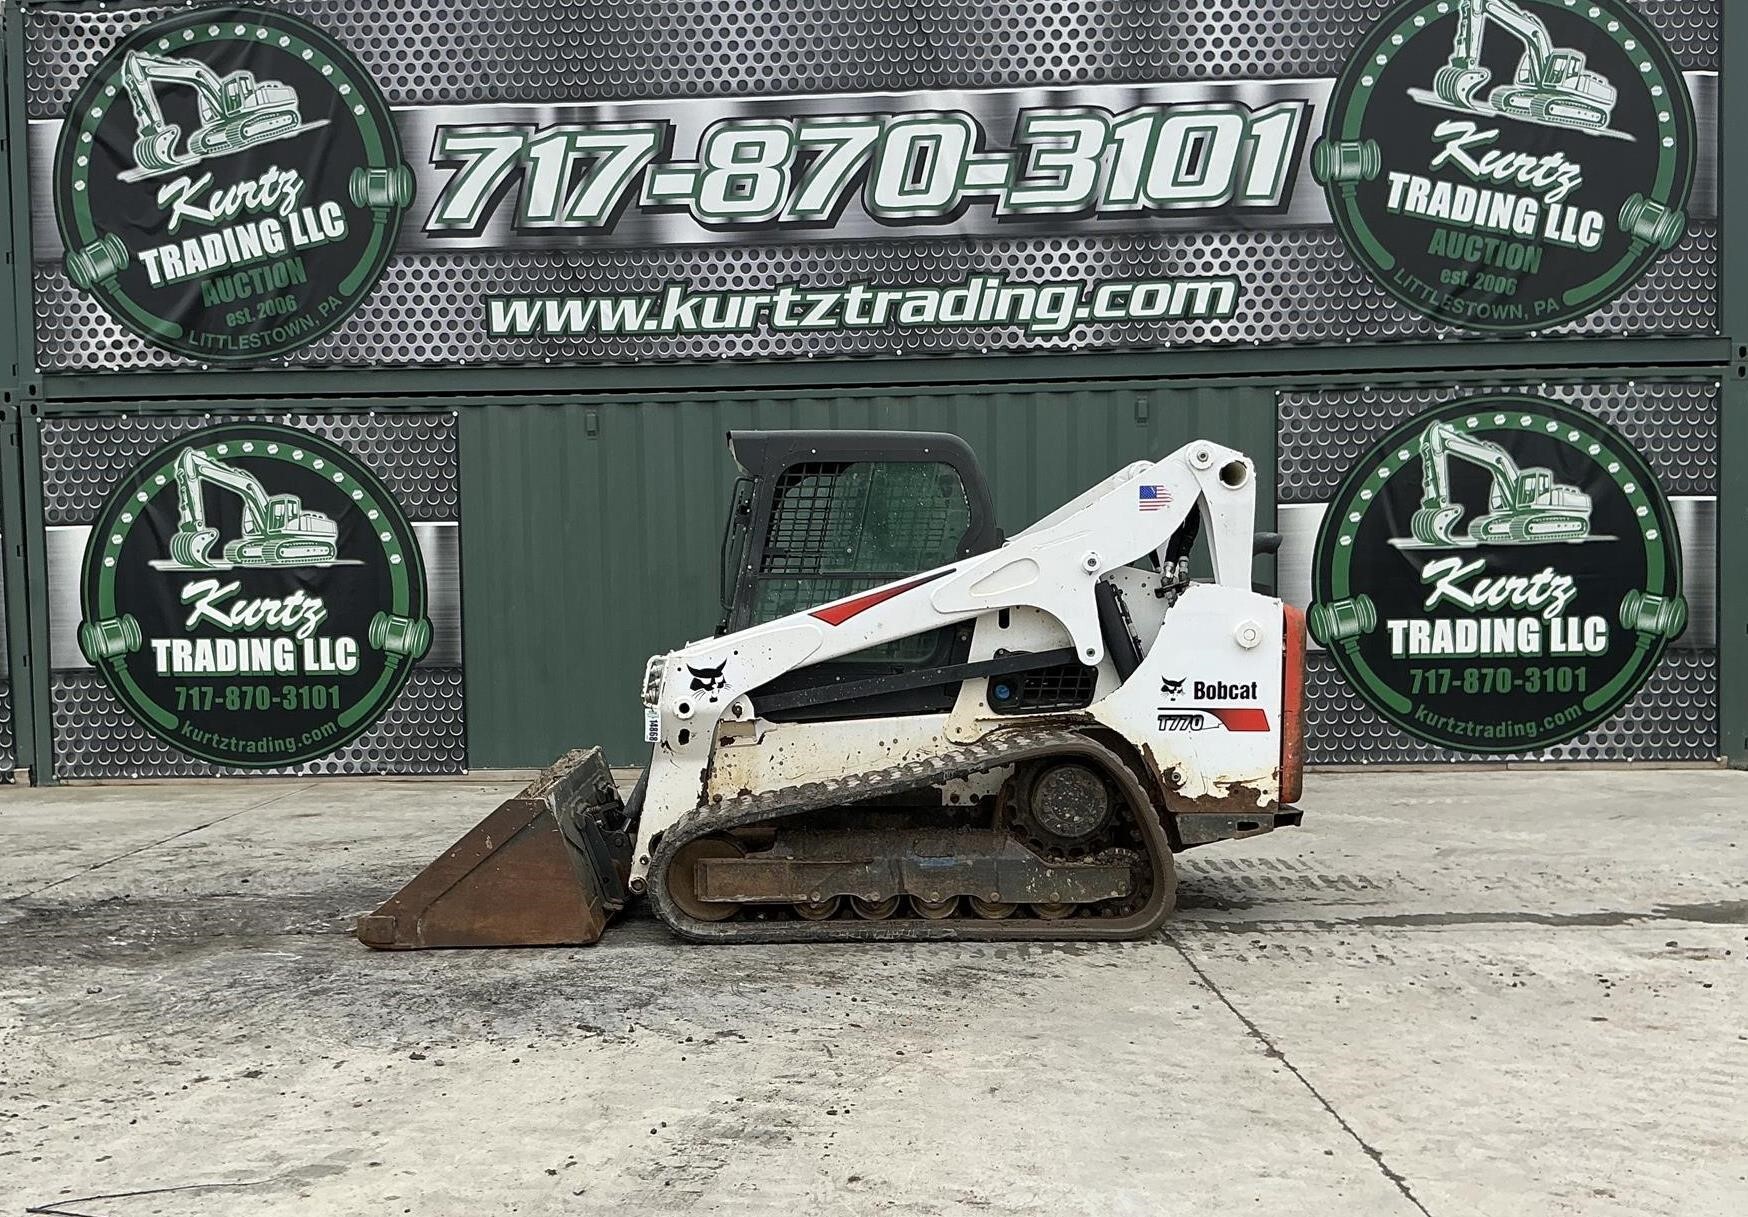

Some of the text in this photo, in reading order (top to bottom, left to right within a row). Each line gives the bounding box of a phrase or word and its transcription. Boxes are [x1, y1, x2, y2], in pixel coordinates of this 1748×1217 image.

[426, 99, 1308, 235] 717-870-3101
[1431, 120, 1583, 203] Kurtz
[157, 165, 304, 229] Kurtz
[1386, 172, 1606, 250] TRADING LLC
[139, 201, 348, 286] TRADING LLC
[1428, 229, 1543, 274] AUCTION
[202, 257, 307, 306] AUCTION
[1394, 267, 1560, 320] LITTLESTOWN, PA
[1440, 269, 1517, 295] est. 2006
[188, 297, 342, 350] LITTLESTOWN, PA
[226, 295, 298, 327] est. 2006
[488, 275, 1238, 337] www.kurtztrading.com
[181, 579, 328, 639] Kurtz
[1420, 556, 1577, 619] Kurtz
[152, 637, 359, 676] TRADING LLC
[1387, 616, 1608, 658] TRADING LLC
[175, 685, 340, 712] 717-870-3101
[1193, 681, 1258, 700] Bobcat
[1410, 666, 1588, 694] 717-870-3101
[180, 719, 338, 754] kurtztrading.com
[648, 719, 659, 742] 14868
[1157, 714, 1205, 732] T770
[1415, 703, 1583, 738] kurtztrading.com
